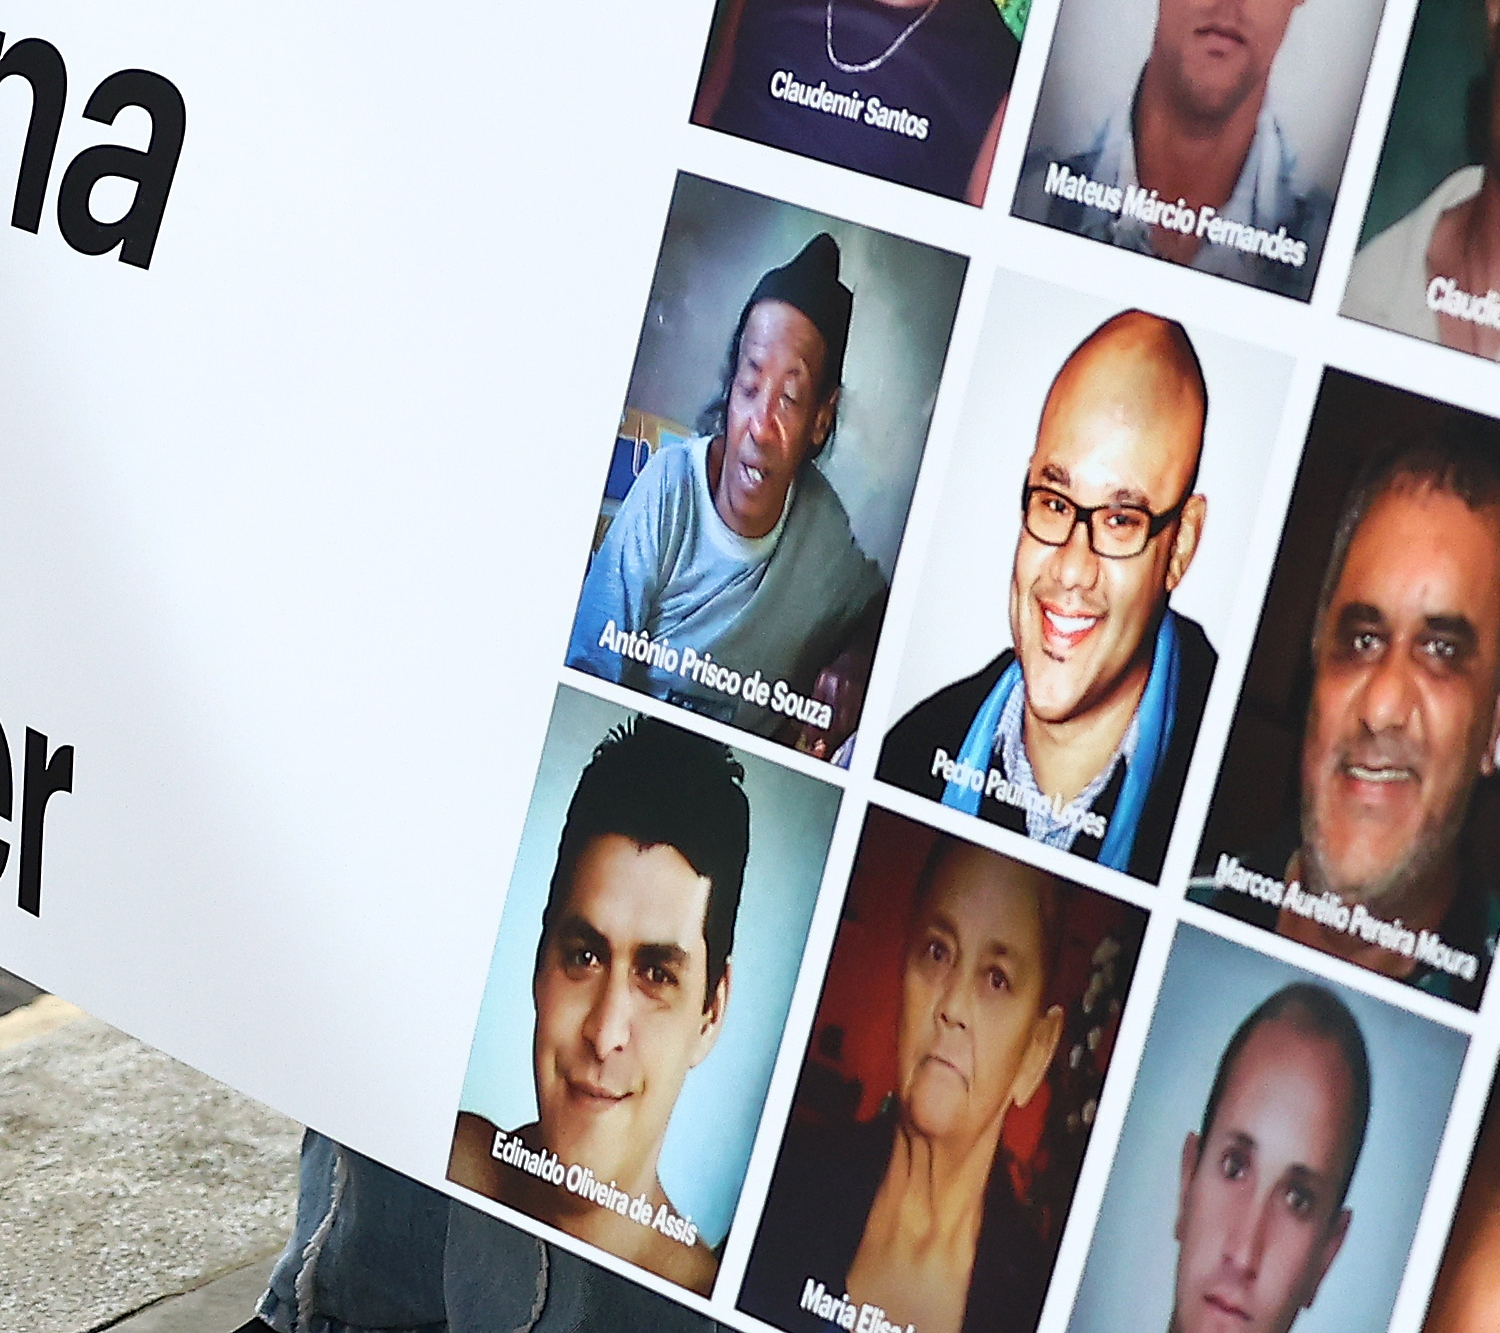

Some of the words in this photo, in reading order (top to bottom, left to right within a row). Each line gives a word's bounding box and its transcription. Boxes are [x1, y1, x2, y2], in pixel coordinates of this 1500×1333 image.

[771, 71, 864, 122] Claudemir
[864, 97, 929, 139] Santos
[1044, 162, 1122, 212] Mateus
[1122, 184, 1196, 234] Márcio
[1196, 205, 1307, 267] Fernandes
[598, 619, 679, 673] Antônio
[680, 646, 740, 696] Prisco
[741, 670, 769, 706] de
[770, 681, 832, 730] Souza
[931, 748, 985, 792] Pedro
[1215, 853, 1284, 906] Marcos
[1350, 903, 1415, 956] Pereira
[1414, 929, 1478, 981] Moura
[492, 1131, 564, 1186] Edinaldo
[566, 1163, 628, 1217] Oliveira
[629, 1193, 652, 1224] de
[651, 1203, 698, 1247] Assis
[800, 1278, 856, 1331] Maria
